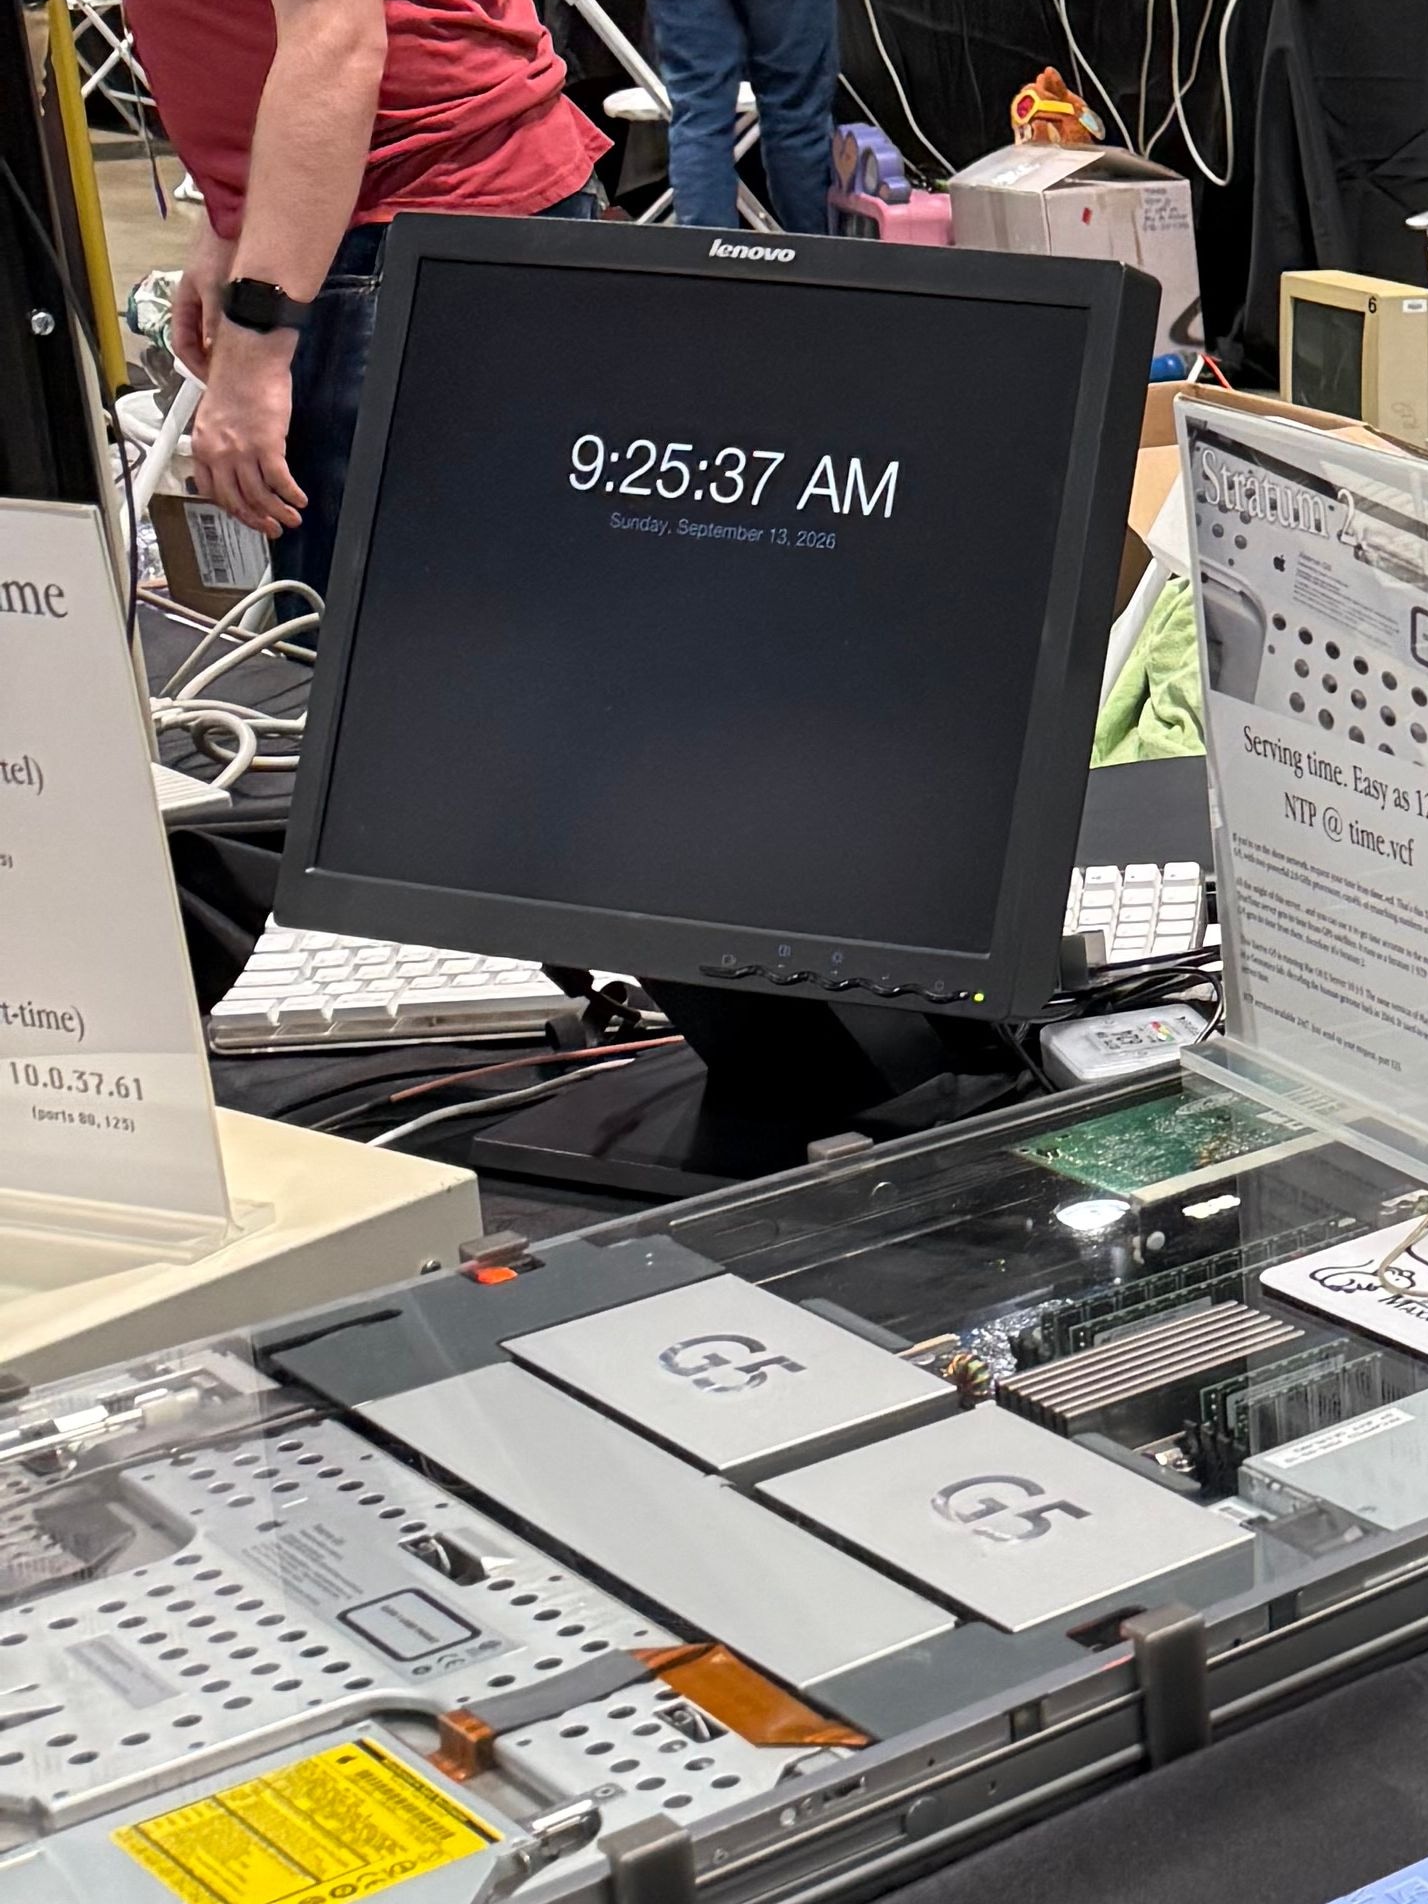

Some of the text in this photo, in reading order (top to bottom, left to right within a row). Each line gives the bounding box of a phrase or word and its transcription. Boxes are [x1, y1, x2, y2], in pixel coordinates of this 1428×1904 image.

[709, 239, 797, 263] lenovo
[1367, 296, 1378, 314] 6
[568, 434, 899, 518] 9:25:37 AM
[1201, 449, 1358, 548] Stratum 2
[609, 512, 672, 535] Sunday,
[676, 518, 764, 543] September
[795, 531, 837, 549] 2026
[1243, 725, 1303, 779] Serving
[1307, 750, 1348, 788] time.
[1353, 765, 1388, 810] Easy
[1394, 786, 1410, 812] as
[1284, 791, 1415, 867] NTP @ time.vcf
[10, 1061, 143, 1101] 10.0.37.61
[32, 1105, 74, 1123] (ports
[658, 1333, 808, 1394] G5
[930, 1474, 1094, 1544] G5
